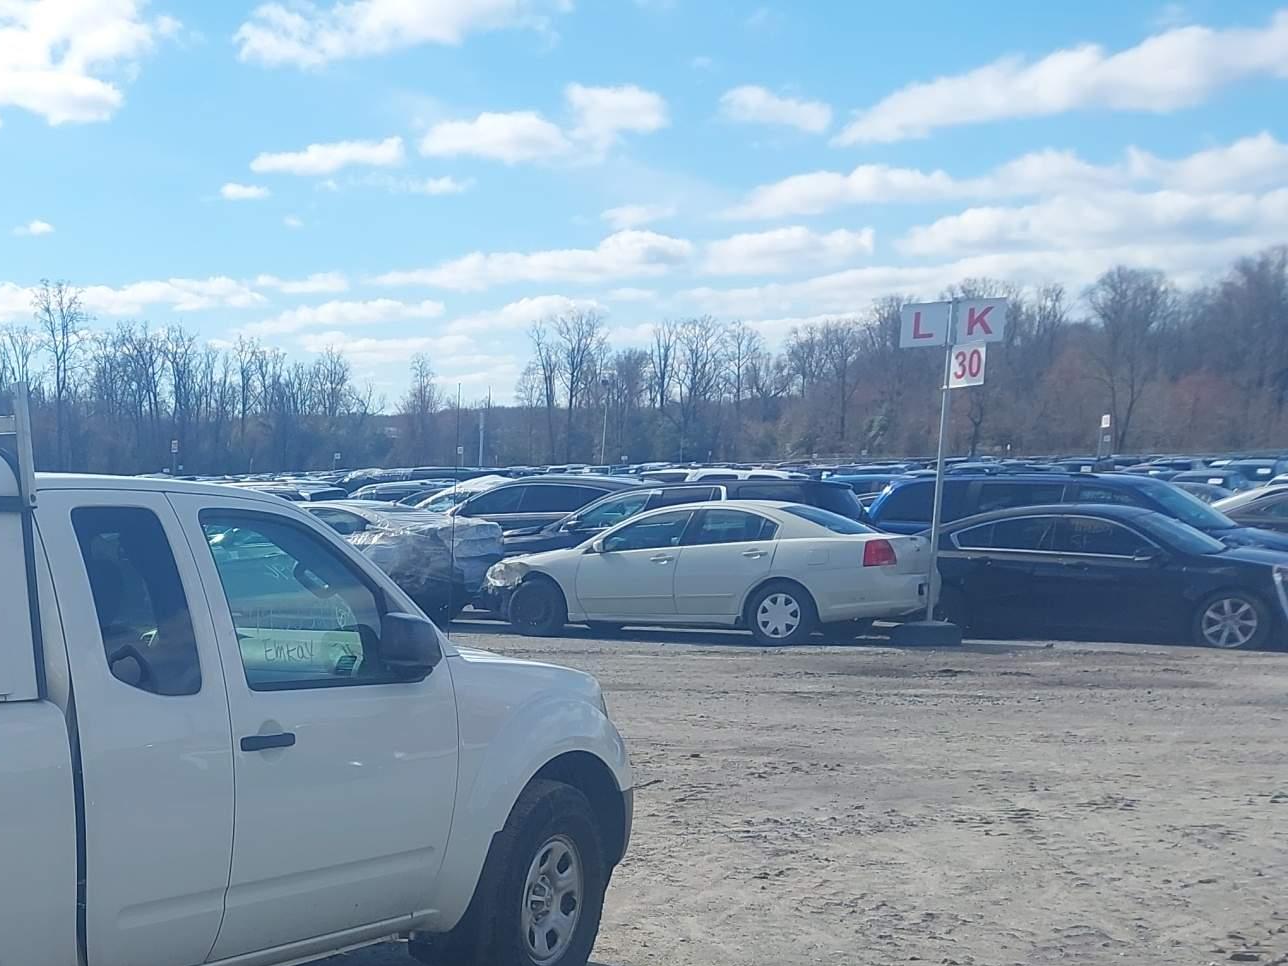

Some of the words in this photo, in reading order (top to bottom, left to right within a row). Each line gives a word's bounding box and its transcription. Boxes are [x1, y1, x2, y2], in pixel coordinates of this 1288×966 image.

[912, 311, 934, 340] L
[966, 306, 995, 336] K
[953, 348, 982, 380] 30
